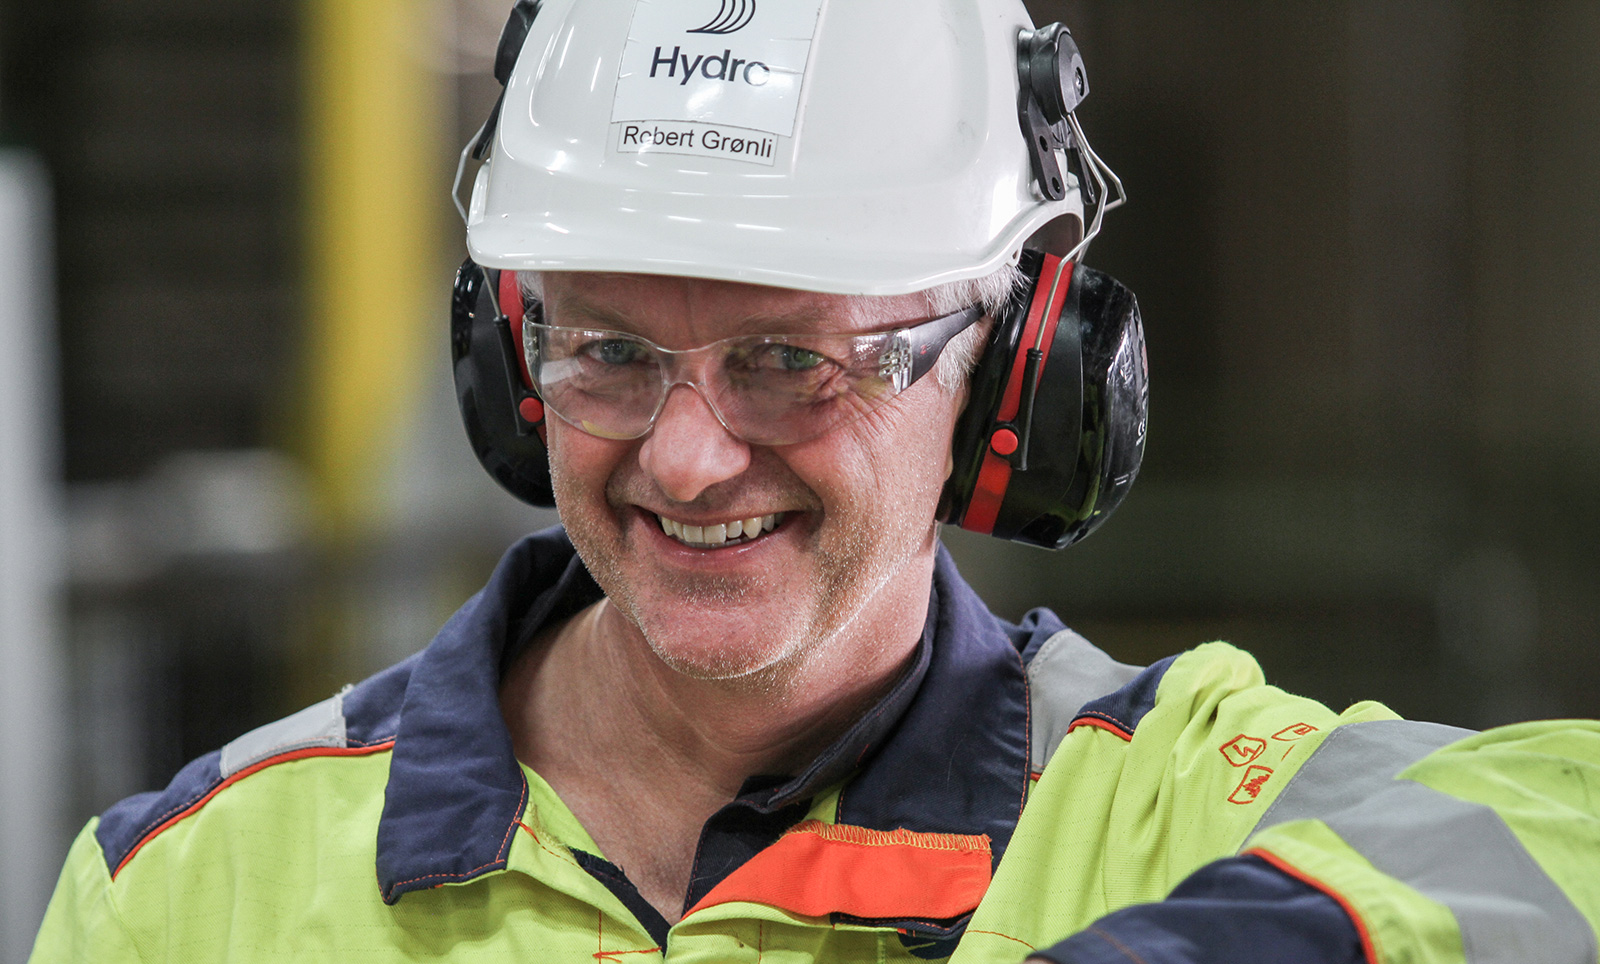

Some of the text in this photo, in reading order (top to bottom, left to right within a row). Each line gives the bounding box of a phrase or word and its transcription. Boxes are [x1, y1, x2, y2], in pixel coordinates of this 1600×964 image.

[649, 45, 770, 86] Hydro
[623, 125, 773, 158] Robert Grønli
